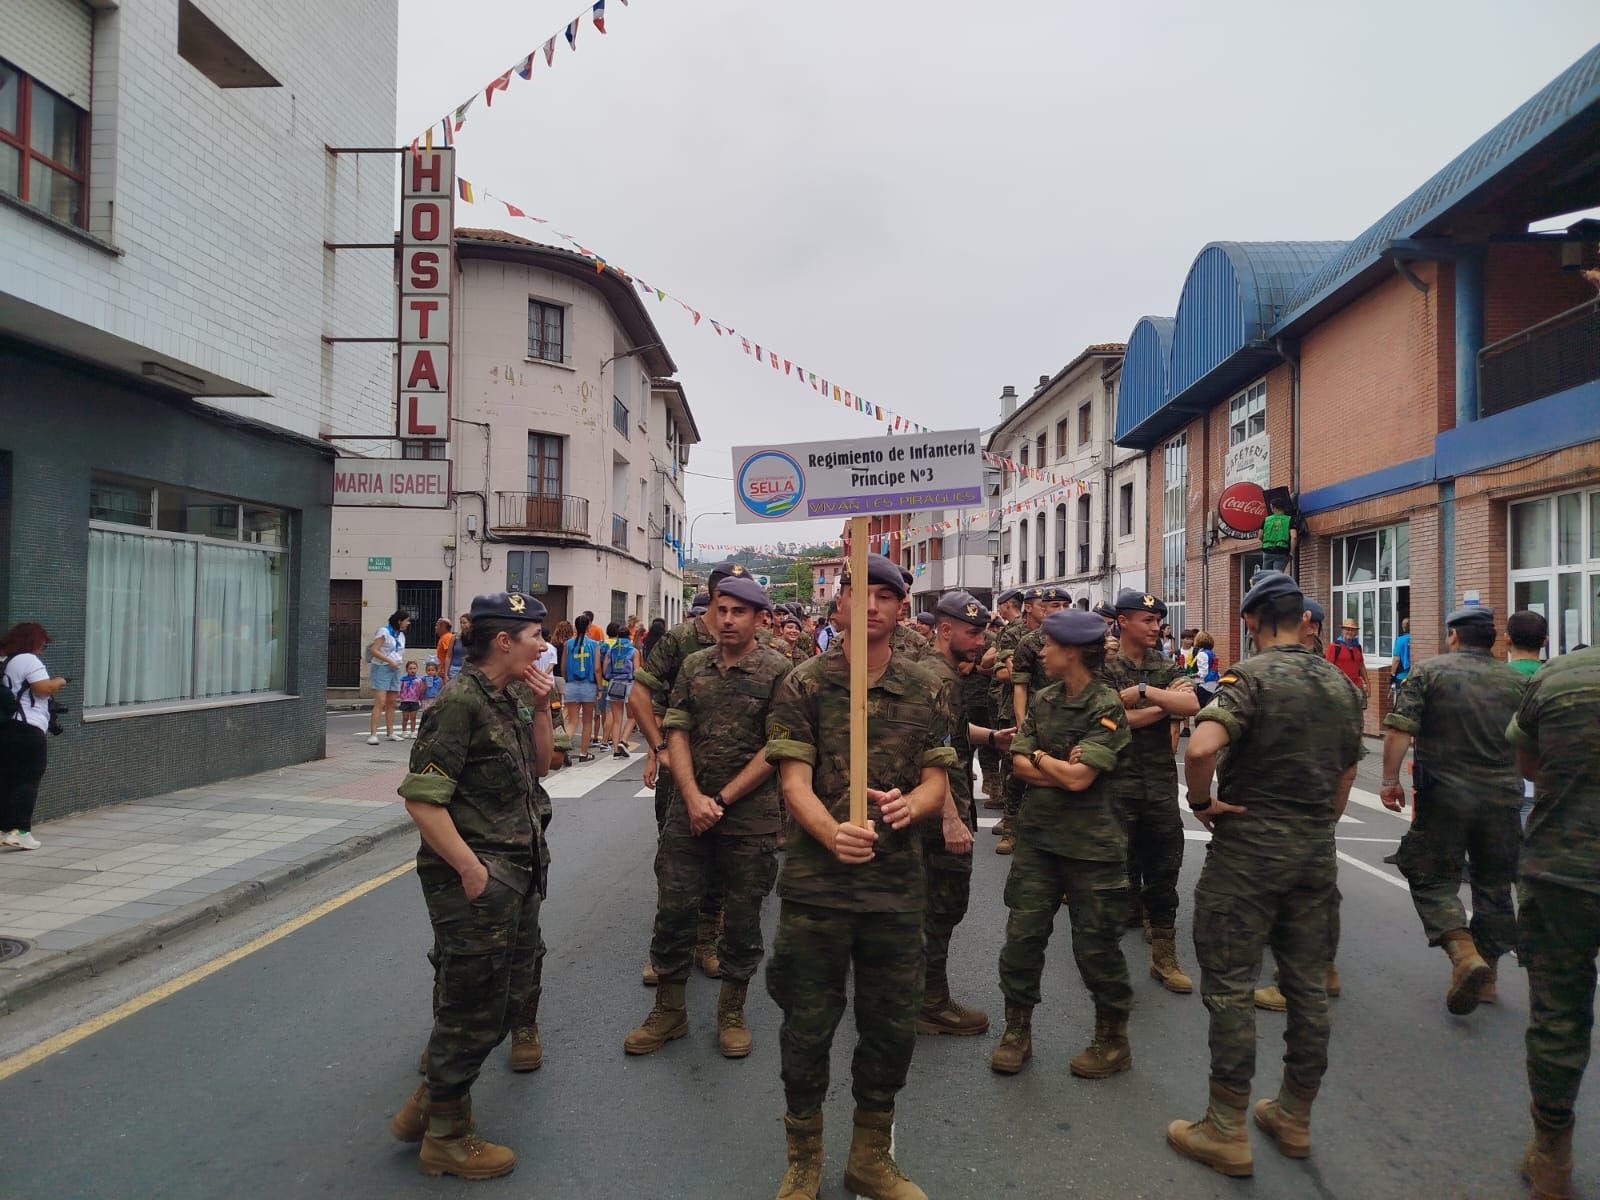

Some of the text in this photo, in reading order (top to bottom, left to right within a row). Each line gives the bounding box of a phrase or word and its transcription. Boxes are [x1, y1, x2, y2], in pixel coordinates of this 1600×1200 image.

[407, 154, 441, 435] HOSTAL
[808, 440, 976, 469] Regimiento de Infantería
[335, 472, 446, 495] MARIA ISABEL
[750, 480, 794, 494] SELLA
[809, 500, 860, 513] VIVAN
